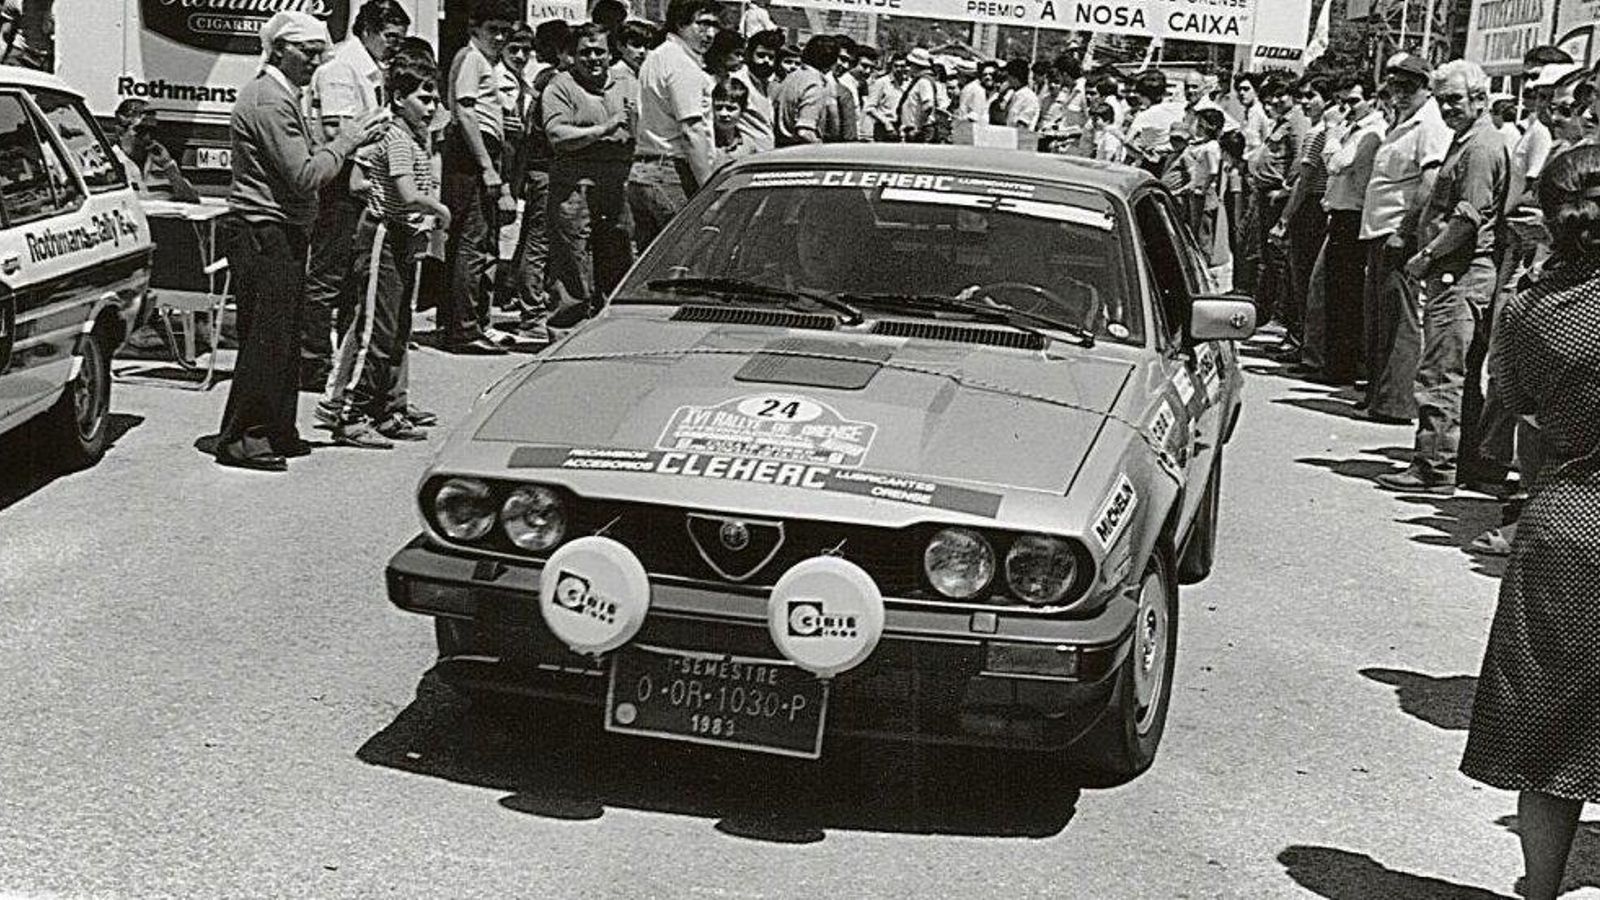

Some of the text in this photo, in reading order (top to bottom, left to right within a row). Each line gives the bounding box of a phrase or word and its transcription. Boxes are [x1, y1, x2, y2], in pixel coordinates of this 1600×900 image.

[196, 18, 264, 31] CIGARRI
[967, 1, 1025, 18] PREMIO
[1076, 3, 1145, 28] NOSA
[118, 76, 238, 102] Rothmans
[25, 228, 93, 263] Rothmans
[757, 399, 801, 418] 24
